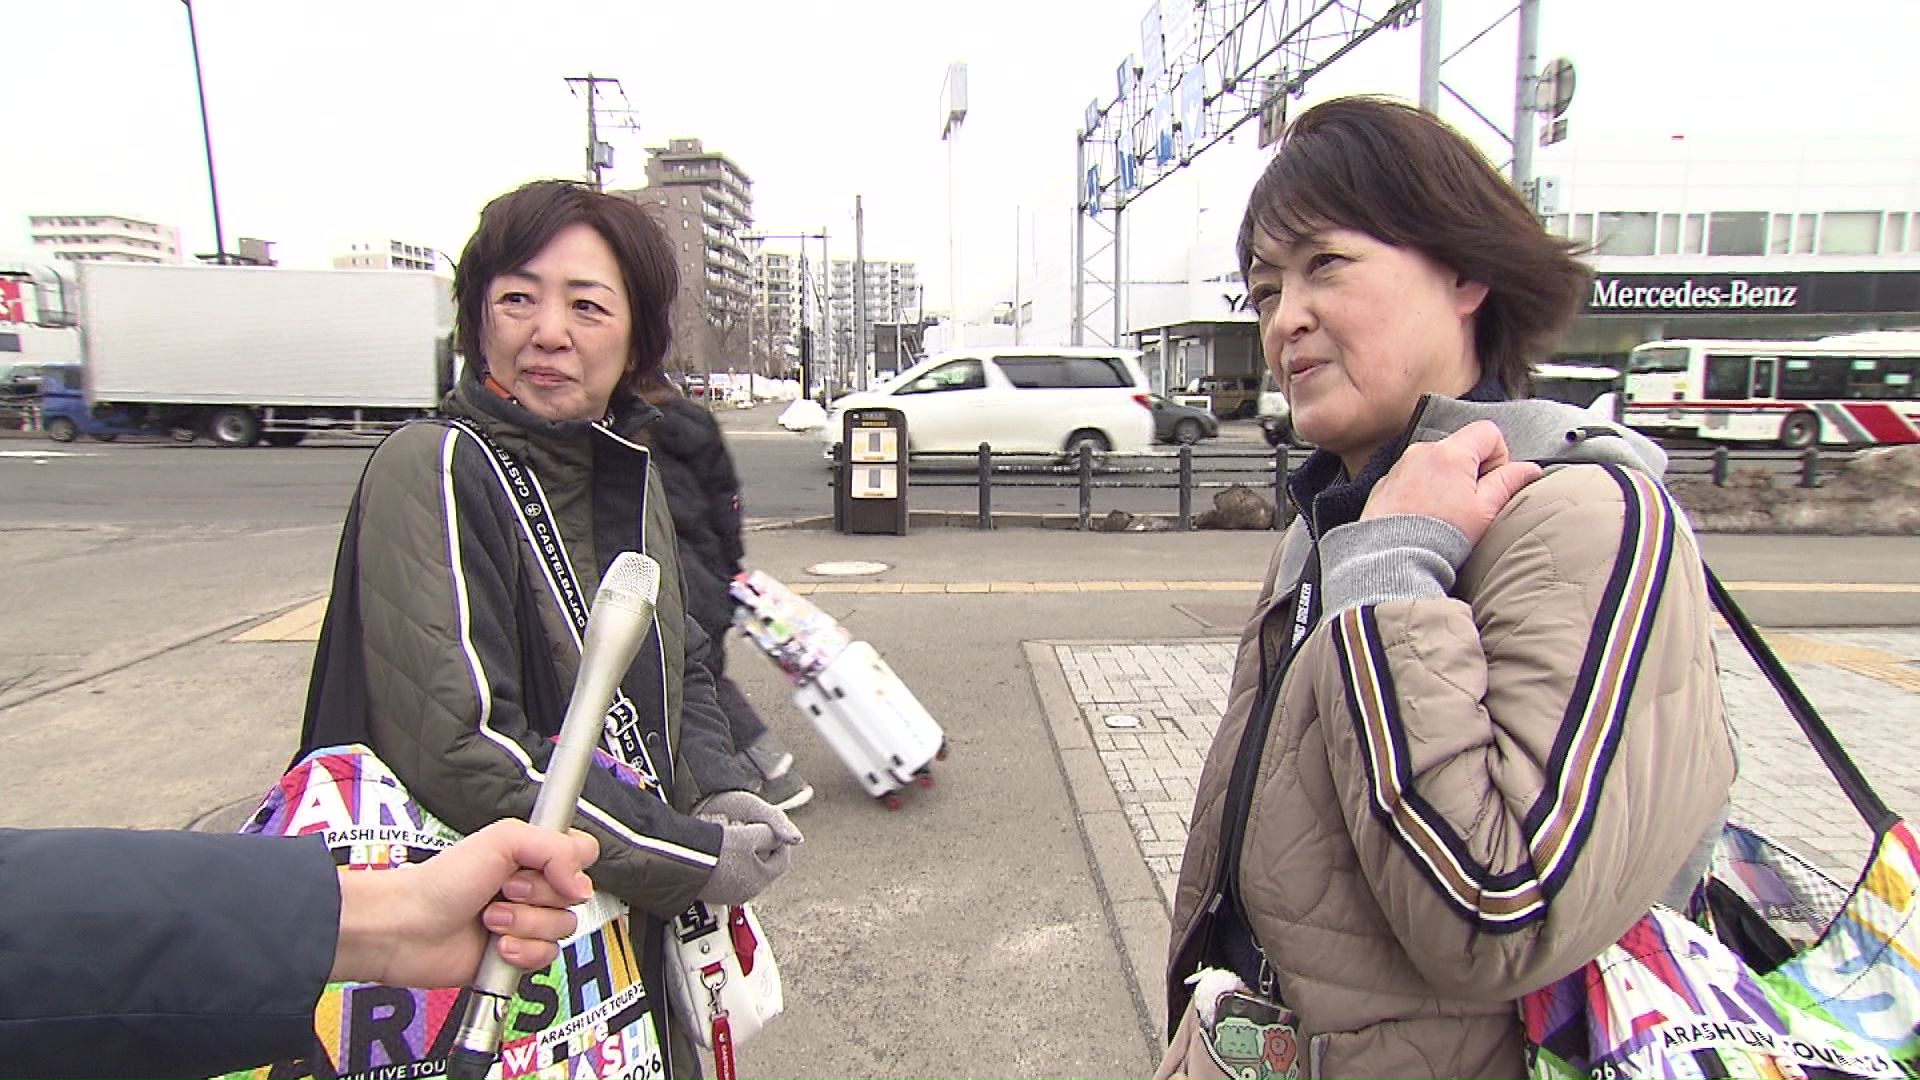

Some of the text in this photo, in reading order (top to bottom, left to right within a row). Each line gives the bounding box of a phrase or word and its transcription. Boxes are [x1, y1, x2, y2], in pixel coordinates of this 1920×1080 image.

[1589, 279, 1799, 307] Mercedes-Benz
[327, 829, 375, 844] RASHI
[379, 829, 410, 842] LIVE
[350, 845, 408, 864] are
[540, 1020, 585, 1046] ARASHI
[586, 1004, 608, 1026] LIVE
[609, 989, 634, 1011] TOUR
[503, 1020, 609, 1075] We are
[411, 1058, 447, 1077] TOU
